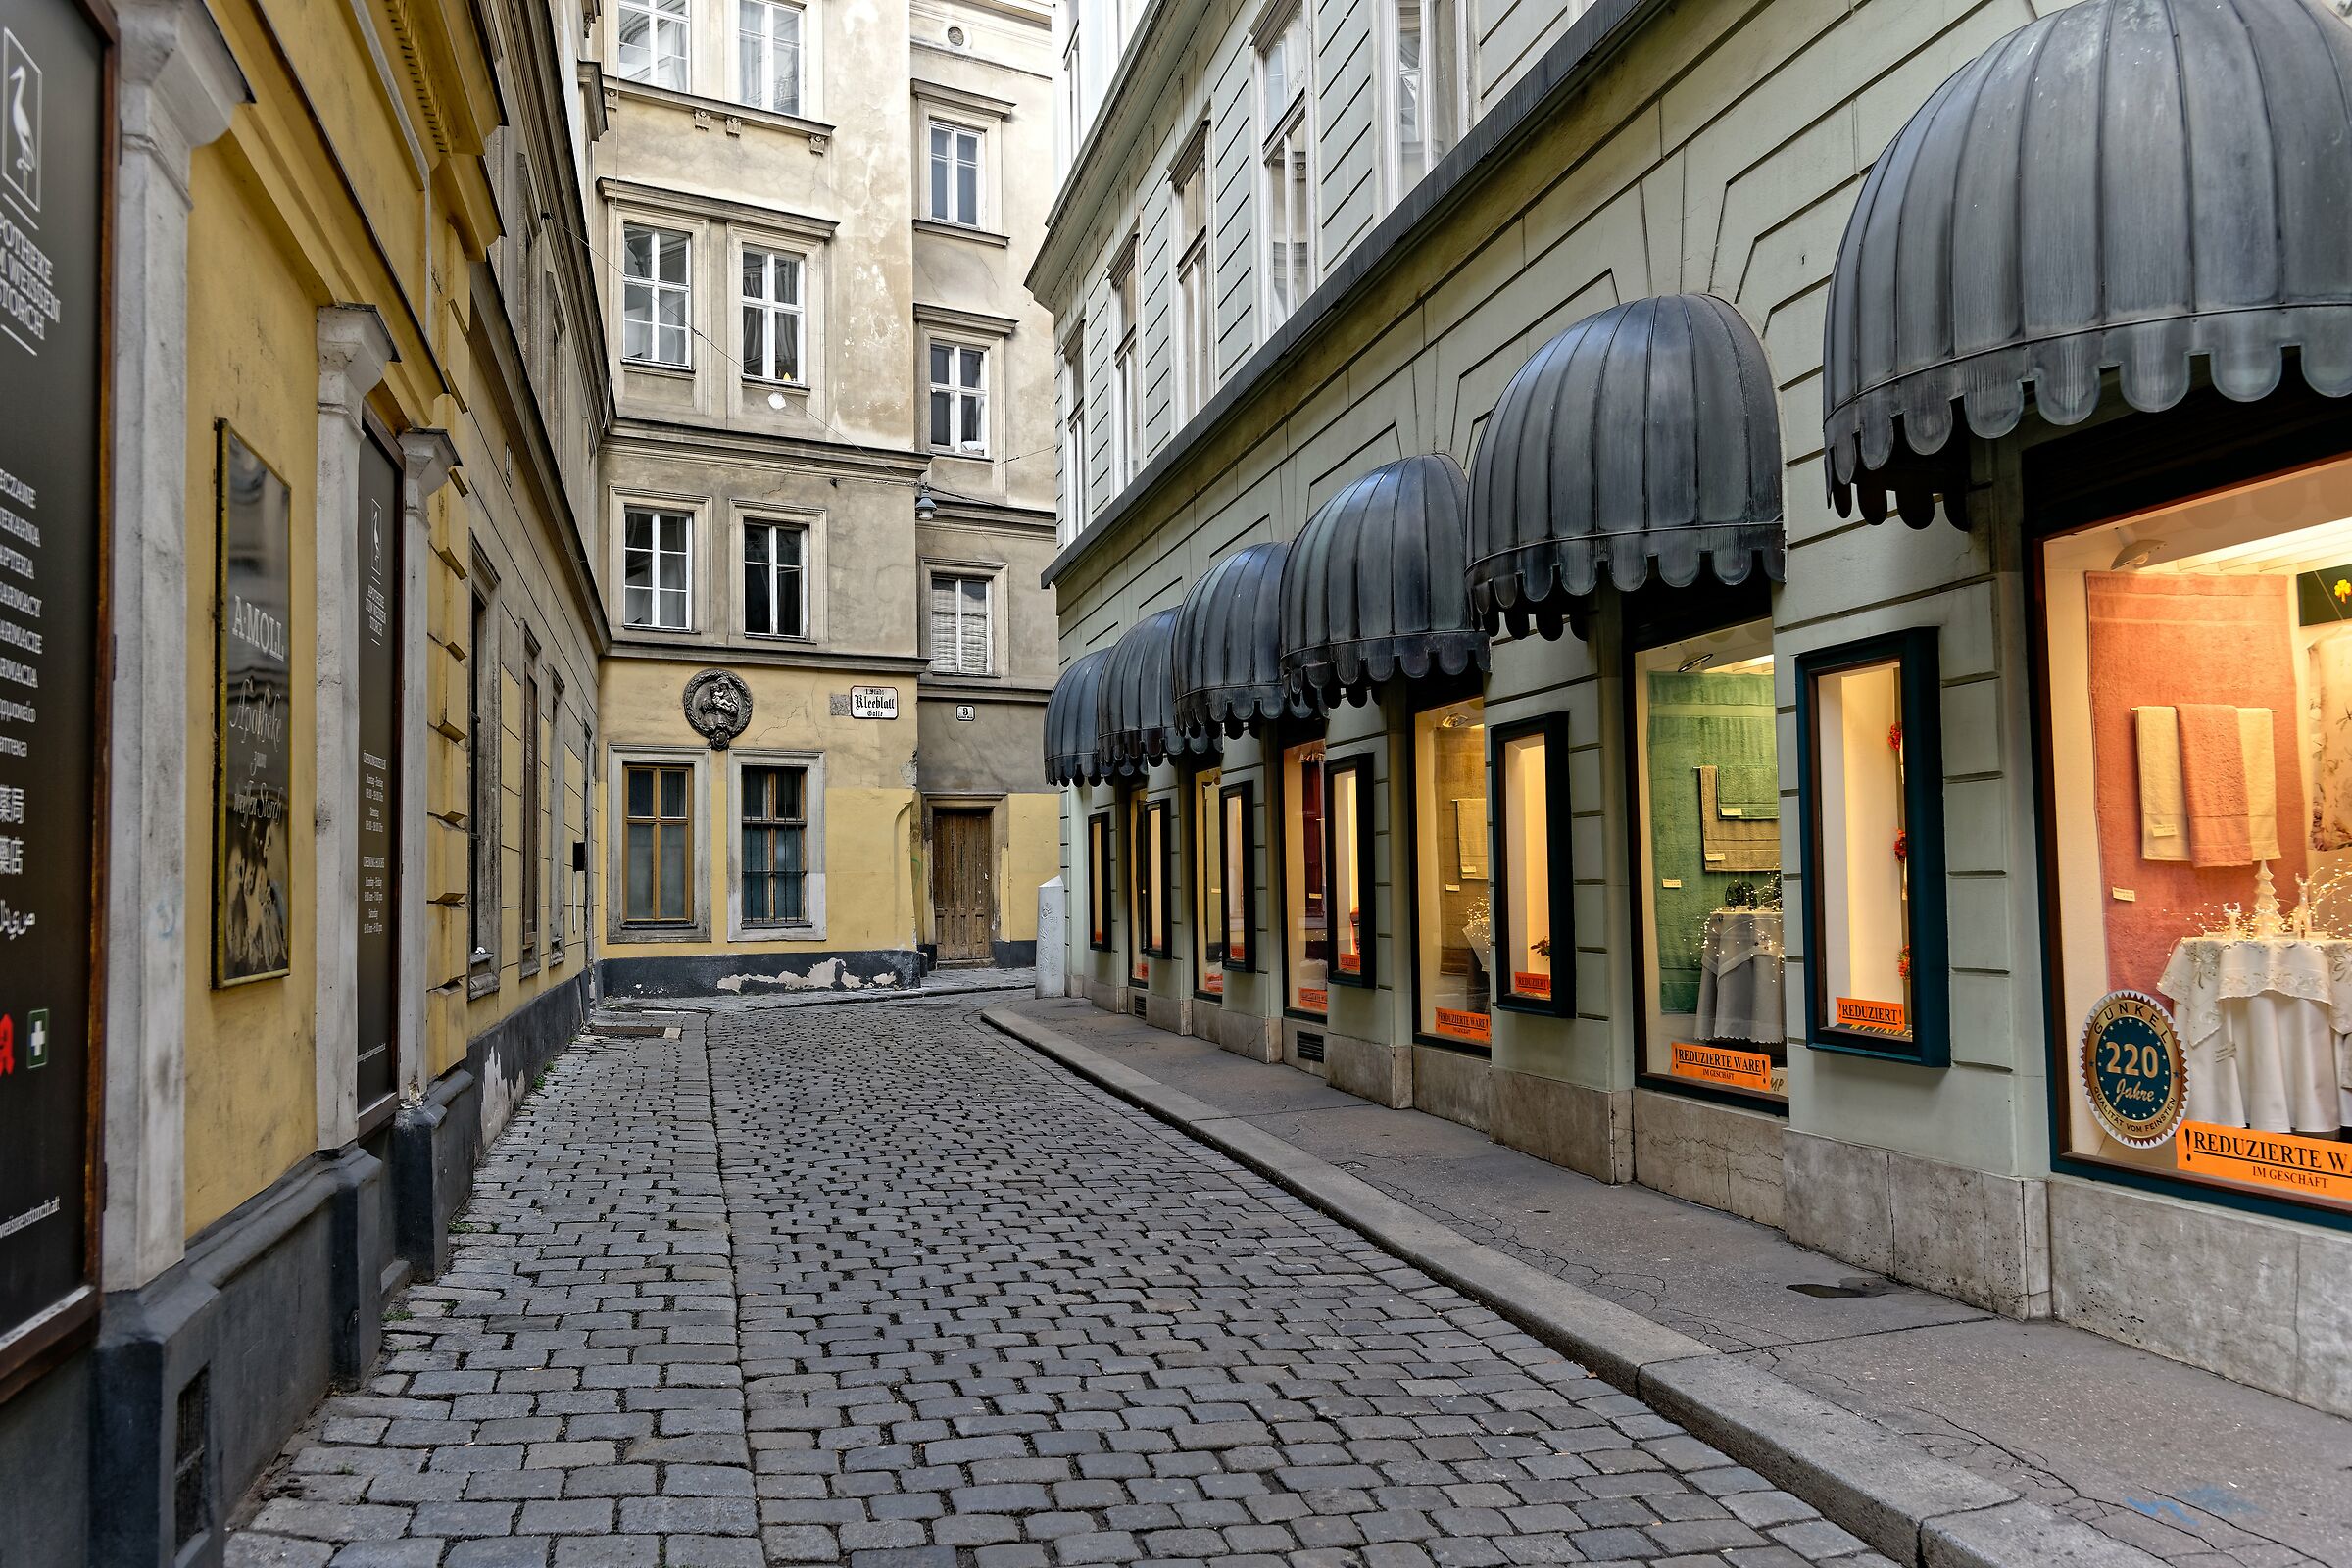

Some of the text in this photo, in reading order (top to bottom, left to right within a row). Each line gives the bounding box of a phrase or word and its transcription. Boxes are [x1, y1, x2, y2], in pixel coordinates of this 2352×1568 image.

[854, 694, 895, 710] Kleeblatt
[962, 707, 969, 716] 3
[2094, 1003, 2168, 1044] GUNKEL
[2106, 1041, 2159, 1079] 220
[1709, 1069, 1735, 1080] GESCHÄFT
[2116, 1078, 2155, 1102] Jahre
[2093, 1086, 2176, 1133] QUALITÄT VOM FEINSTEN
[2252, 1165, 2329, 1189] IM GESCHÄFT
